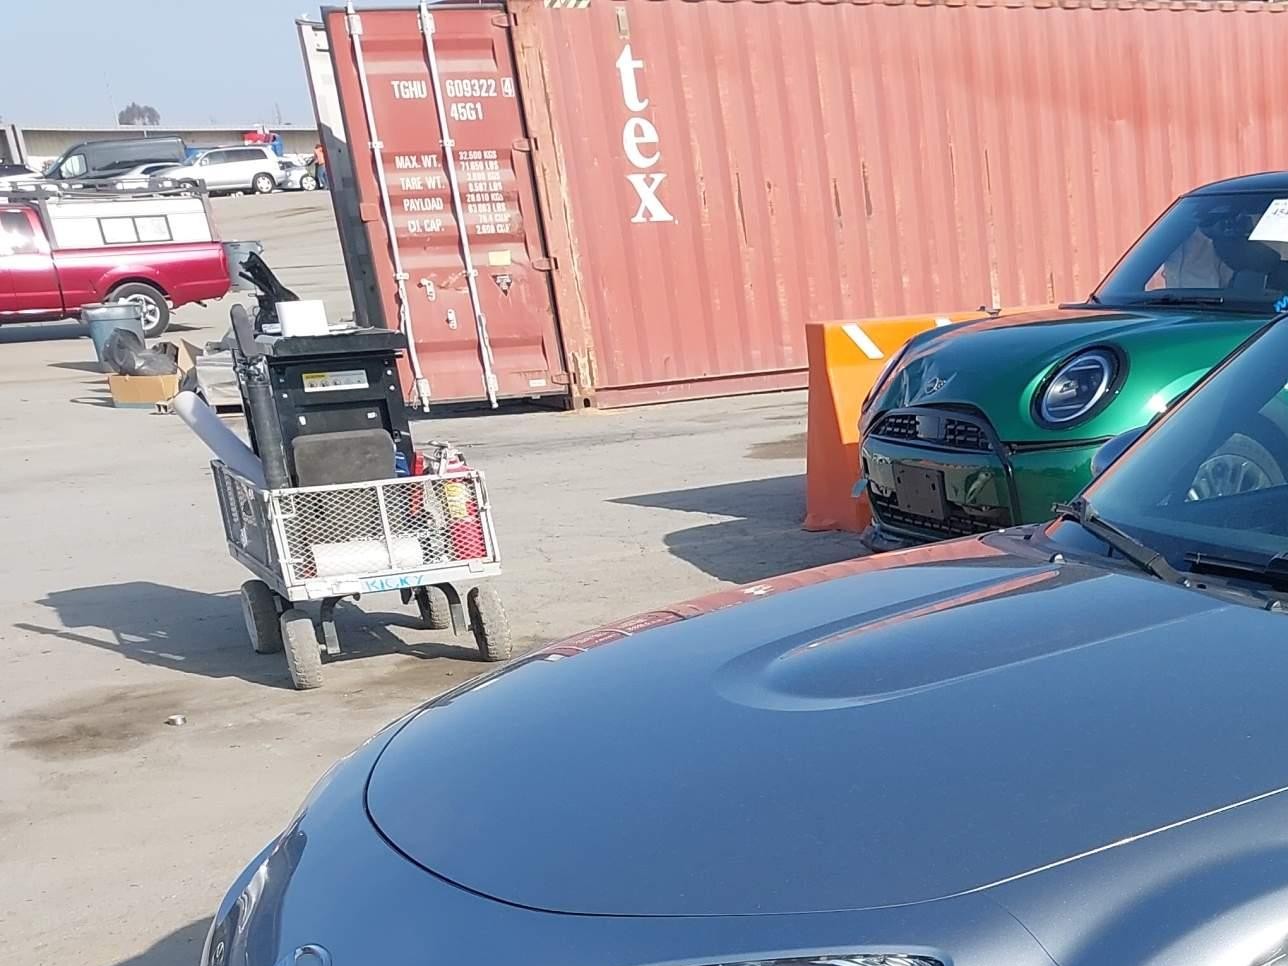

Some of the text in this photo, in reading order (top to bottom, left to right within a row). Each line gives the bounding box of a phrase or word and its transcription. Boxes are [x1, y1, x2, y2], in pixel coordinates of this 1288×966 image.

[391, 80, 427, 98] TGHU
[445, 79, 497, 97] 609322
[450, 102, 483, 120] 45G1
[616, 43, 674, 223] tex
[395, 154, 441, 168] MAX. WT.
[400, 176, 445, 190] TARE WT.
[403, 197, 444, 211] PAYLOAD
[424, 219, 445, 232] CAP.
